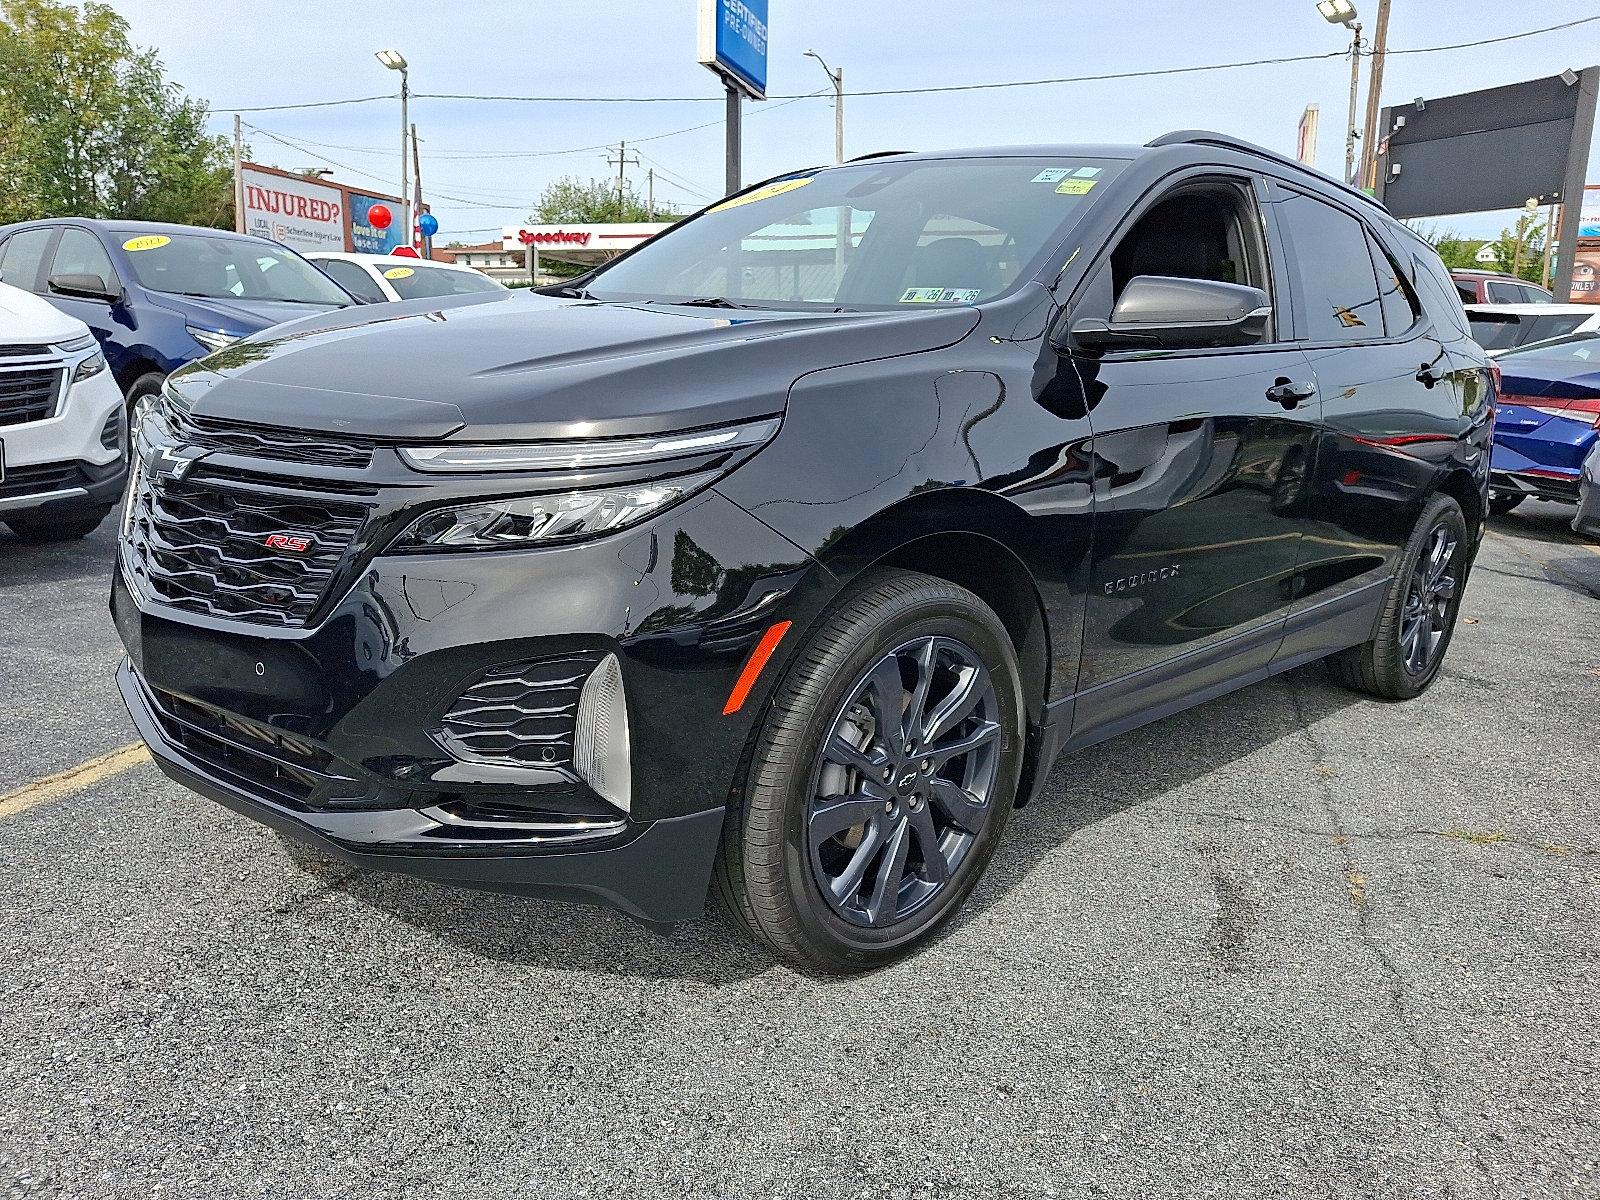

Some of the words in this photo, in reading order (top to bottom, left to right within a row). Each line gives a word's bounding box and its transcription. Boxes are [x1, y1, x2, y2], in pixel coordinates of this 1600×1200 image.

[724, 9, 766, 56] PRE-OWNED
[246, 185, 340, 224] INJURED?
[517, 229, 592, 246] Speedway
[904, 291, 916, 300] 10
[927, 289, 940, 299] 26
[942, 291, 955, 300] 10
[965, 290, 979, 300] 26
[265, 534, 310, 551] RS
[1104, 564, 1181, 594] EQUINOX
